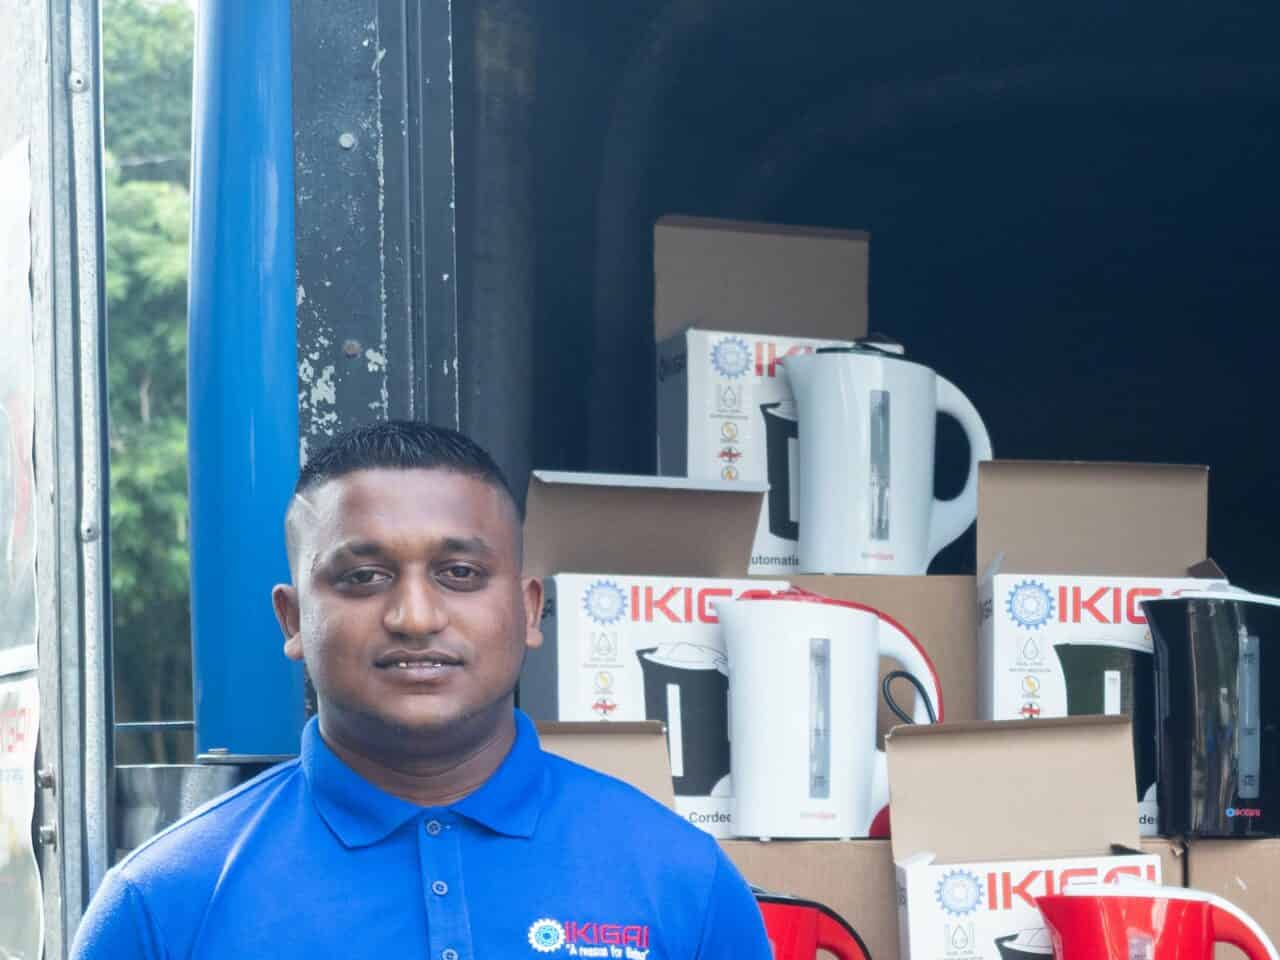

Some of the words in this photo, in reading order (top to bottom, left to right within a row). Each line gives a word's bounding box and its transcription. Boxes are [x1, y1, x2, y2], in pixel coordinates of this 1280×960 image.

[752, 553, 800, 566] utomati
[631, 585, 733, 624] IKIG
[1058, 585, 1163, 624] IKIG
[565, 920, 649, 948] IKIGAI
